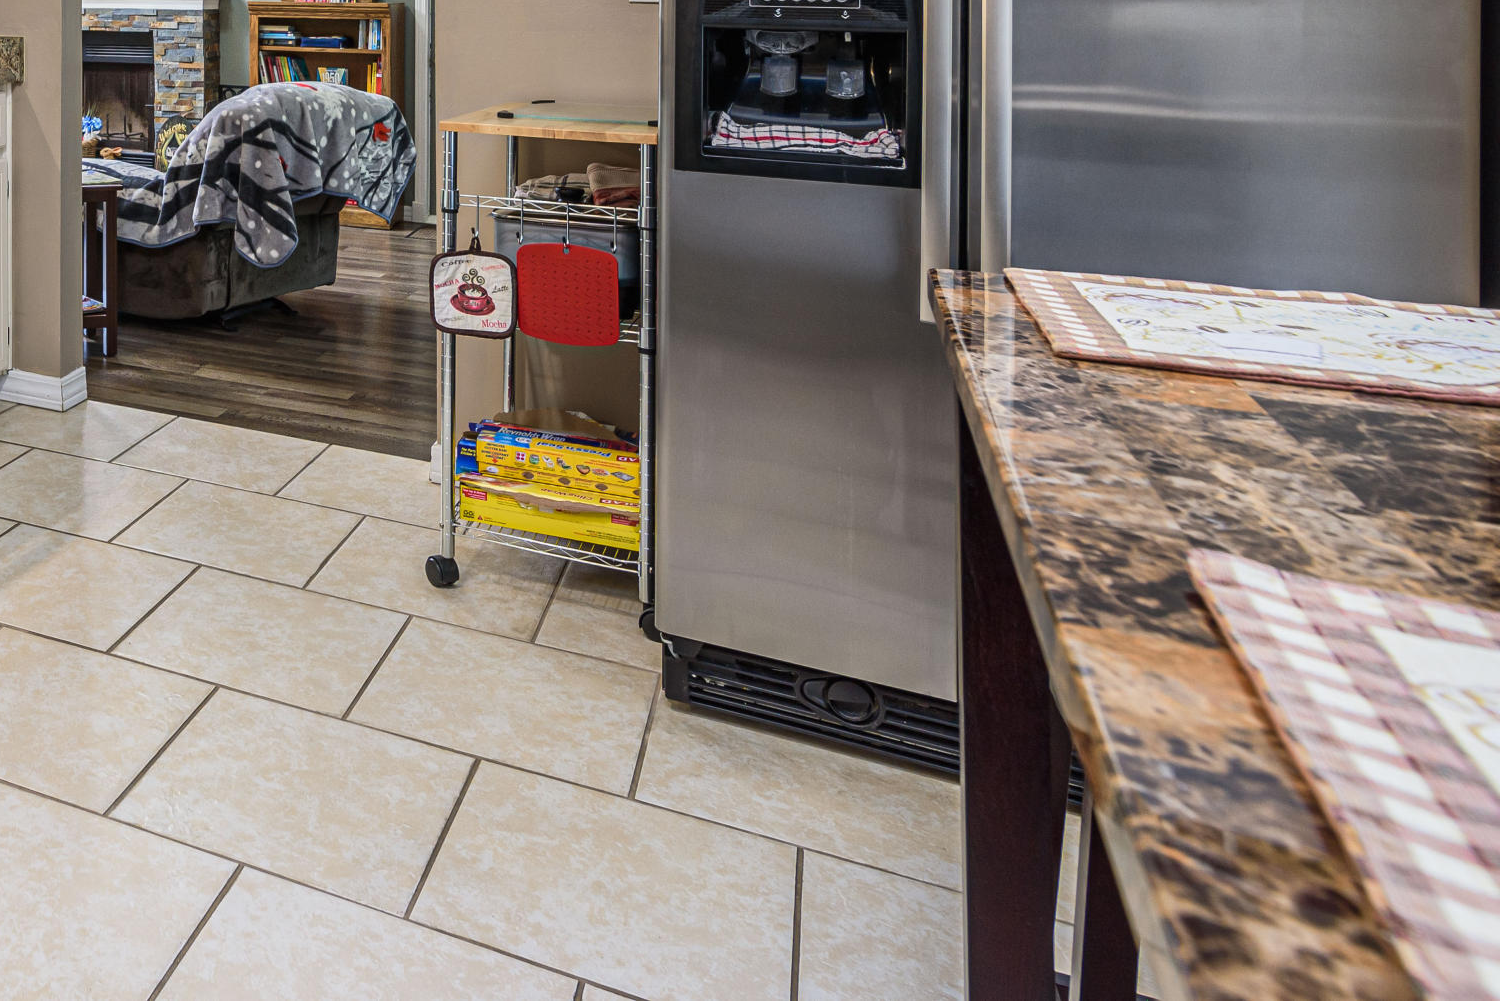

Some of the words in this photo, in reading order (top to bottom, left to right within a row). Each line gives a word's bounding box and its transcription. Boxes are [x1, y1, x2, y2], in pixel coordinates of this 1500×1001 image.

[321, 71, 341, 84] 1950
[441, 259, 472, 268] Coffee
[435, 279, 460, 289] MOCHA
[492, 285, 509, 294] Latte
[481, 318, 507, 329] Mocha
[498, 427, 540, 439] Reynolds
[540, 432, 566, 442] Wrap
[536, 441, 565, 452] Seal
